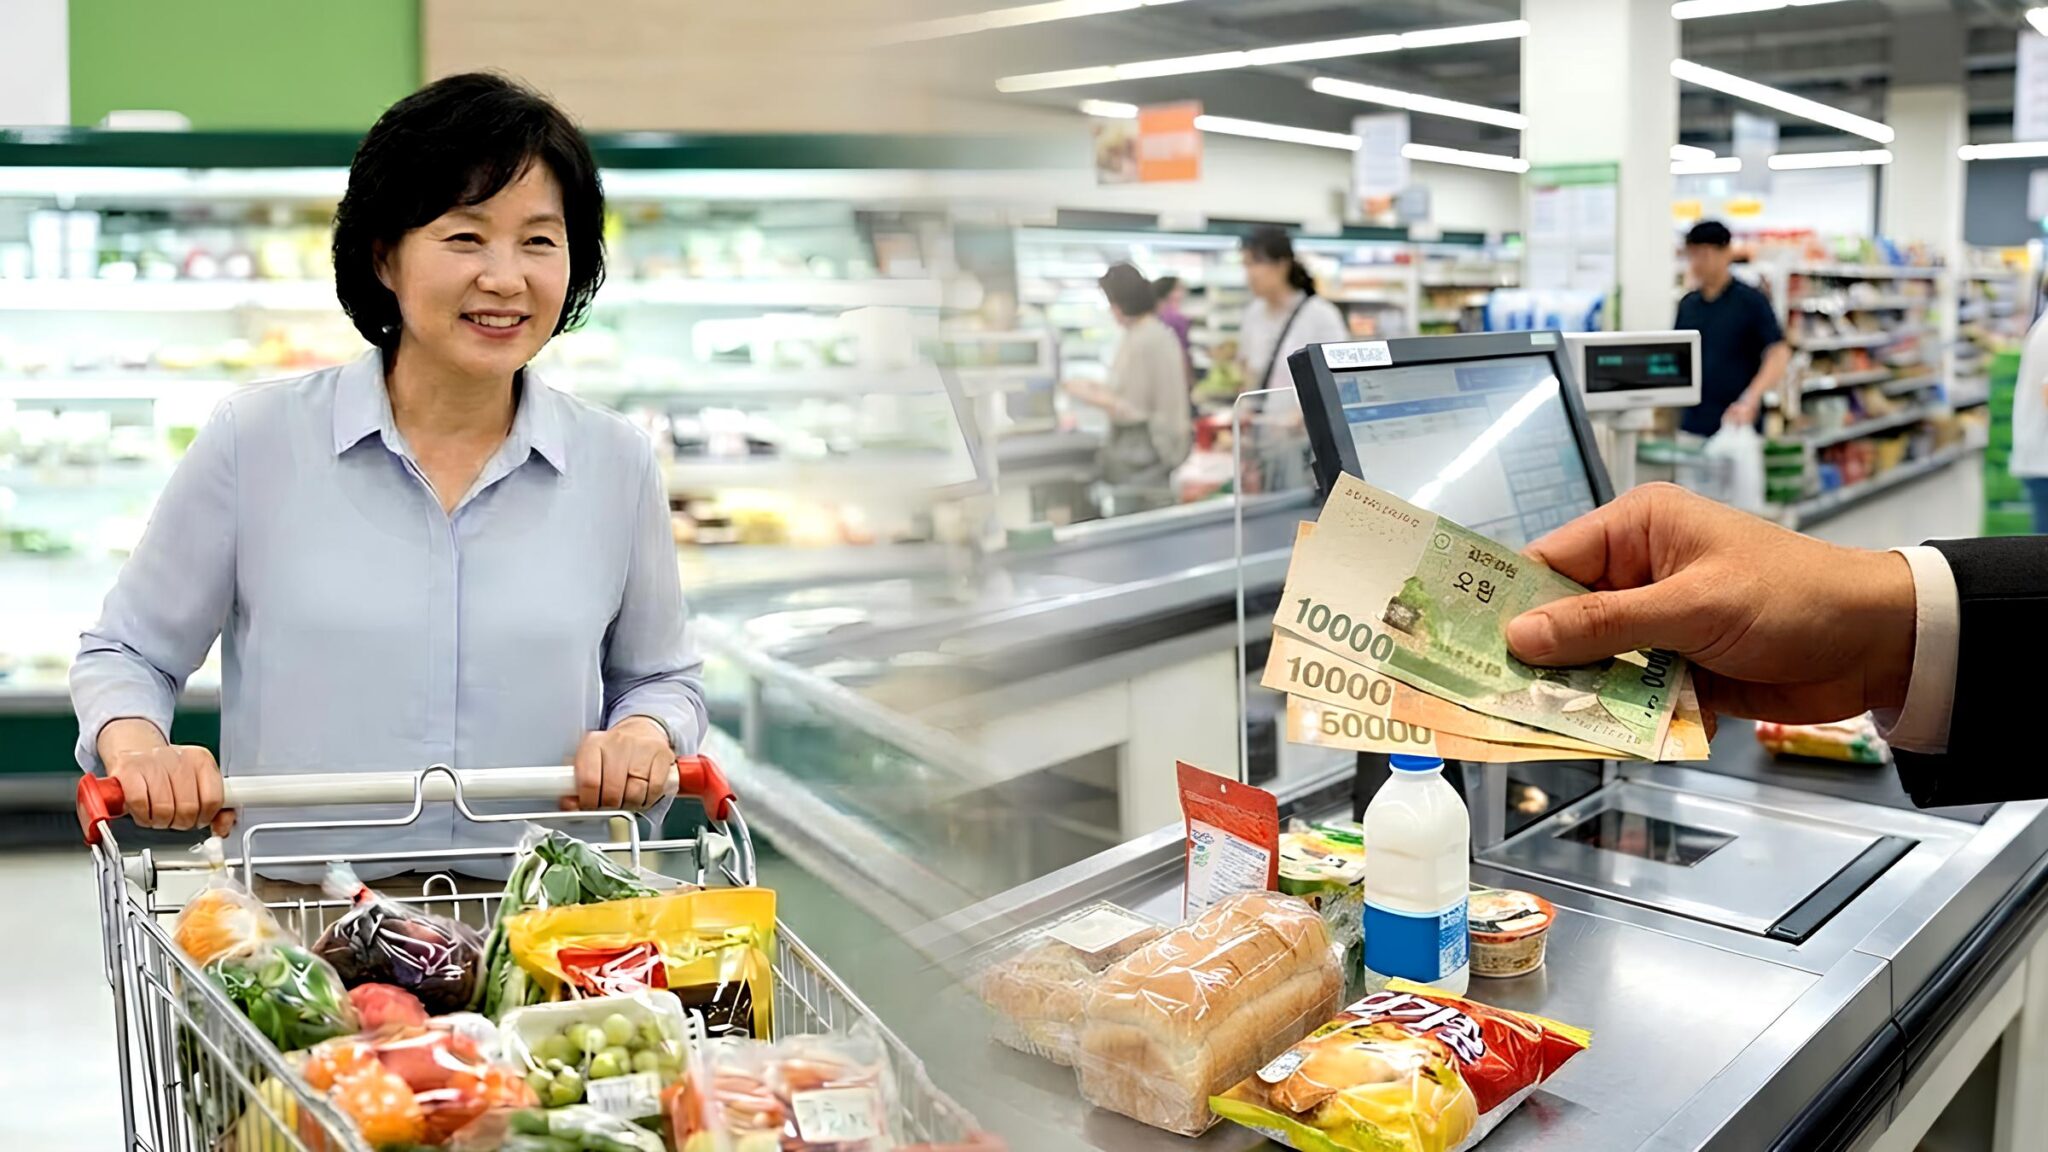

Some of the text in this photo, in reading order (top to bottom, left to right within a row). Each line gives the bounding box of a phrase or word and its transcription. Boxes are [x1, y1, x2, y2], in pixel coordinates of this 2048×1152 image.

[1296, 598, 1394, 662] 10000
[1287, 656, 1392, 706] 10000
[1320, 710, 1432, 745] 50000
